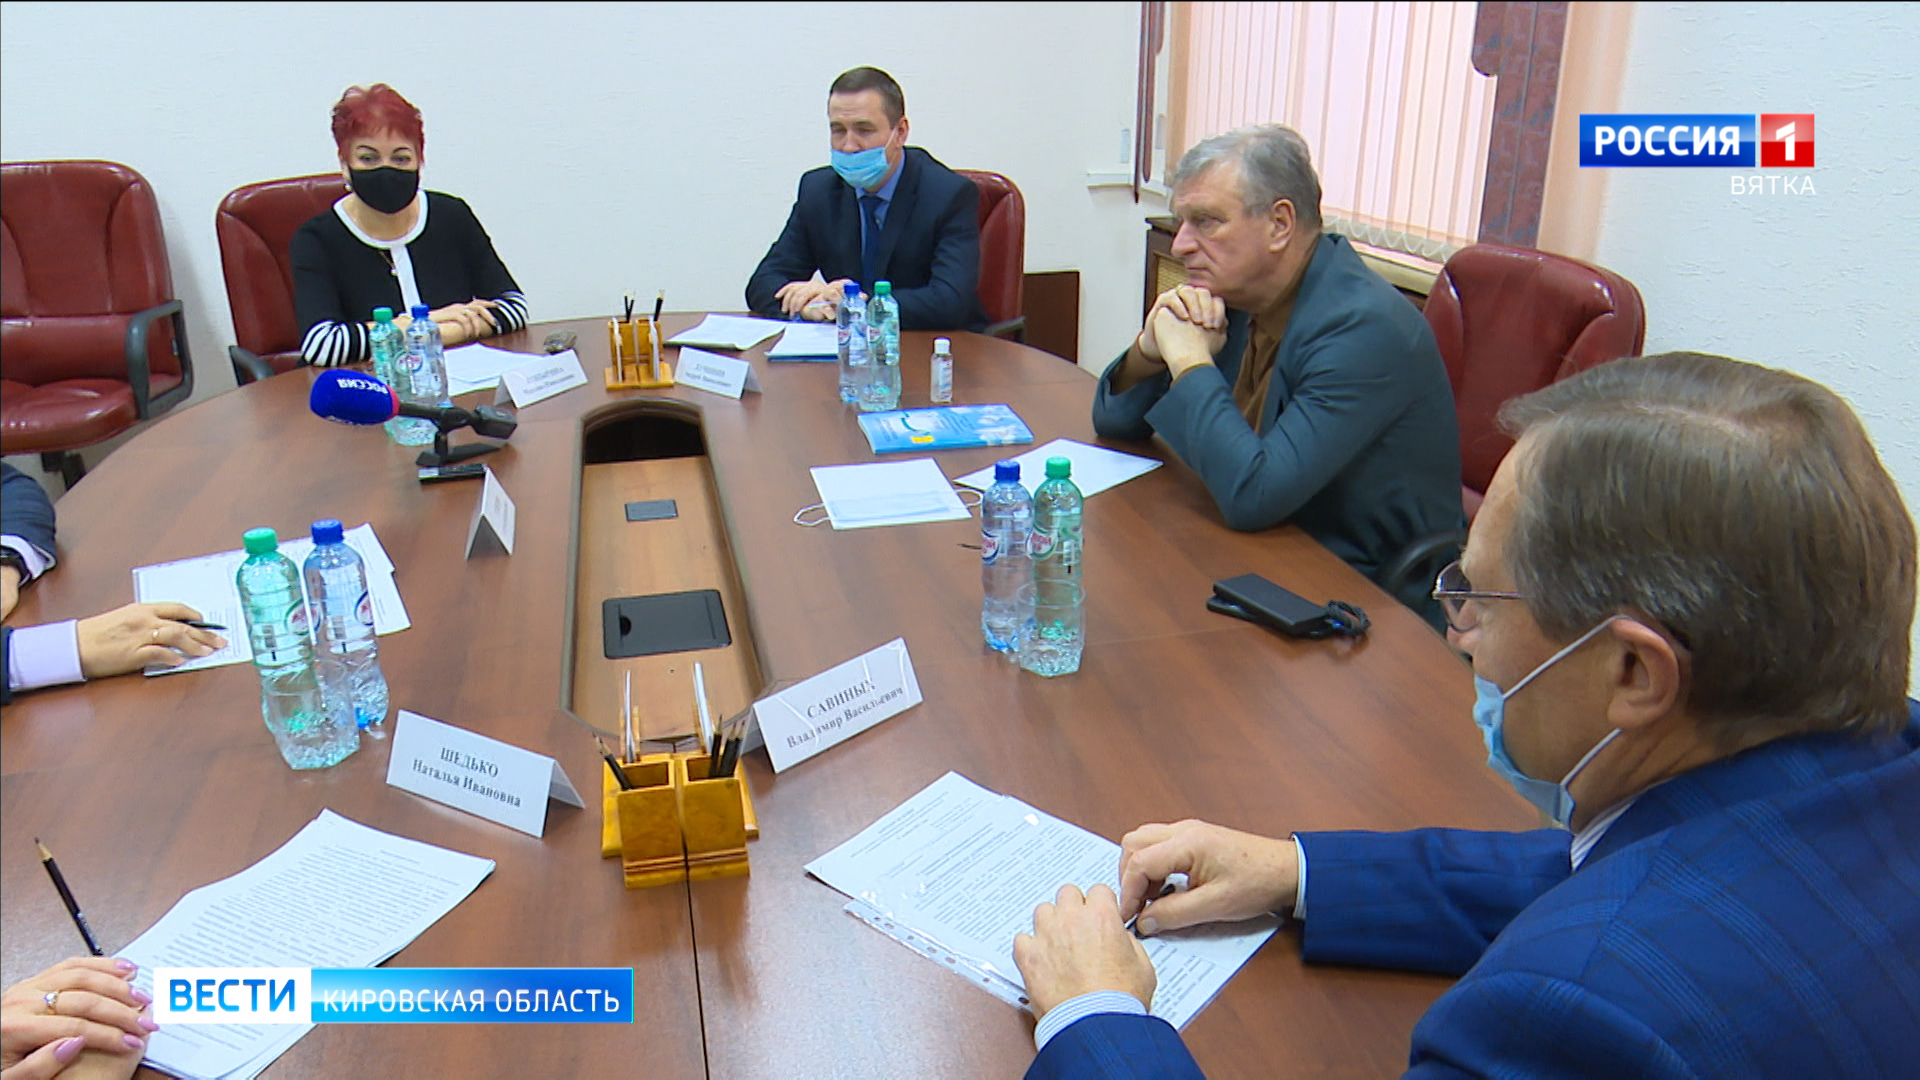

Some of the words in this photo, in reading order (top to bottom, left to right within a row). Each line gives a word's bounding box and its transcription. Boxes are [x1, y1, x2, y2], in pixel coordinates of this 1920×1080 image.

[336, 377, 389, 394] РОССИЯ
[786, 715, 843, 748] Владимир
[844, 688, 903, 722] Васильевич
[807, 679, 876, 718] САВИНЫХ
[440, 747, 499, 778] ШЕДЬКО
[412, 759, 460, 786] Наталья
[463, 775, 521, 807] Ивановна
